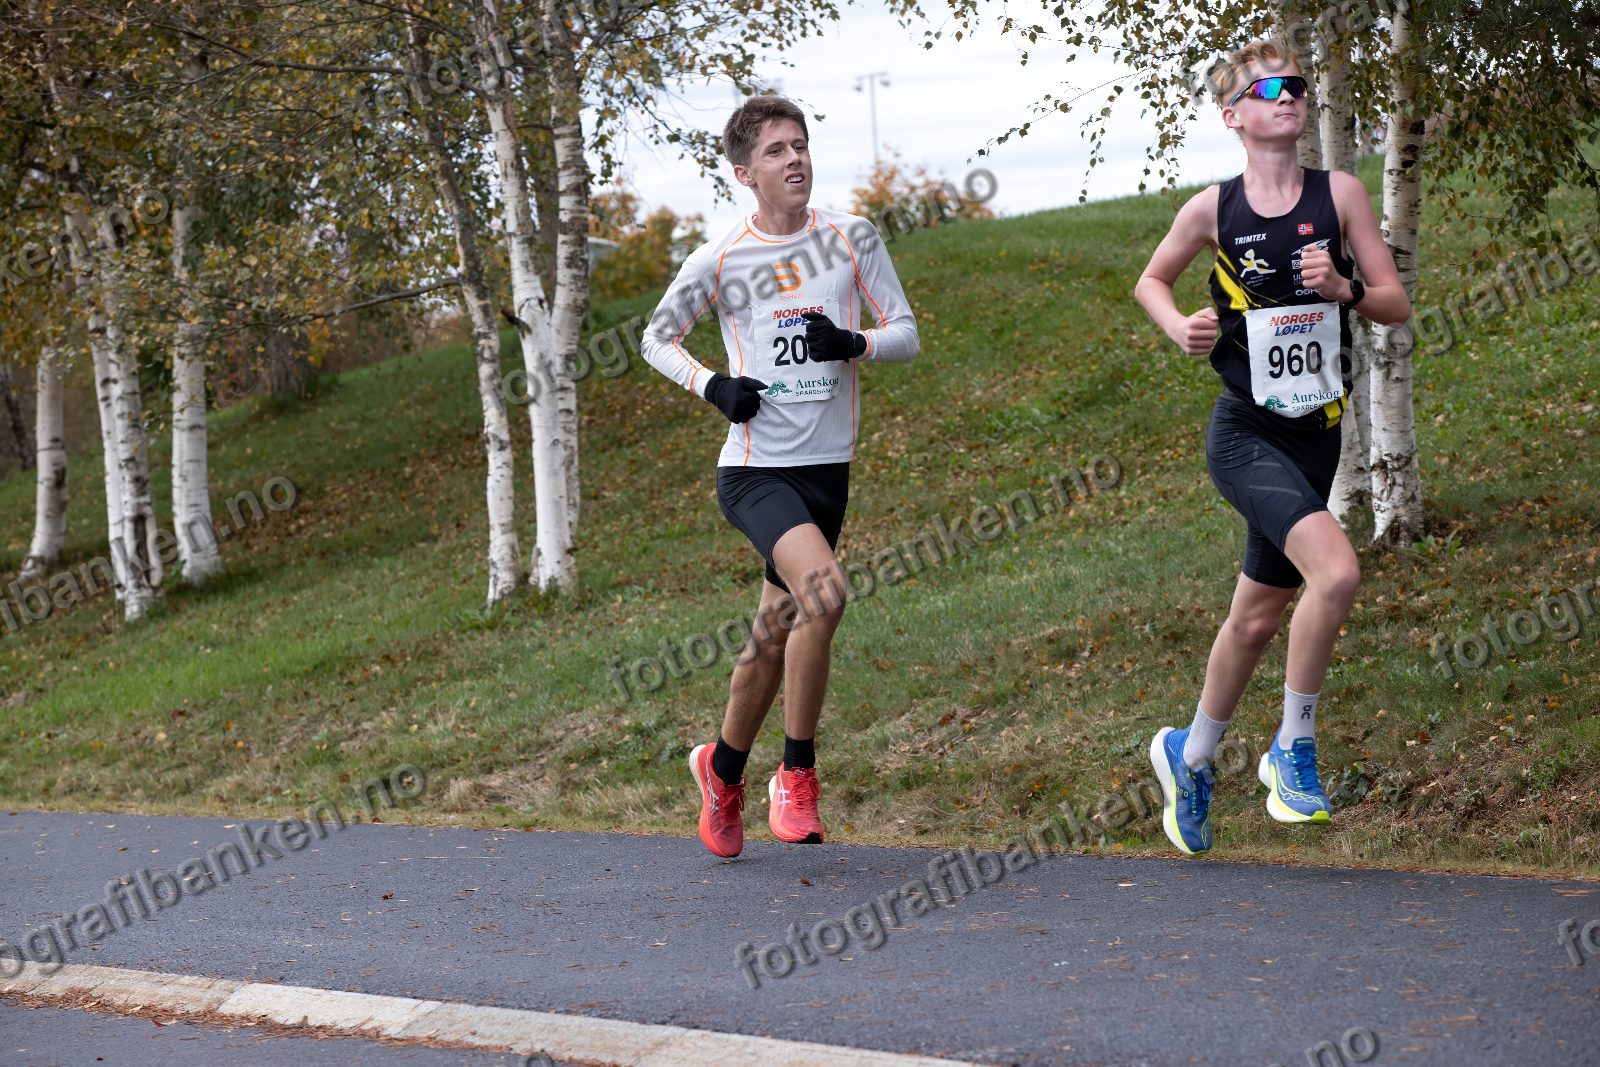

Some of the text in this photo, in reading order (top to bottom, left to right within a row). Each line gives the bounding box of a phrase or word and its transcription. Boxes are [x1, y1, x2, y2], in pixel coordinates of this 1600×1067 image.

[1234, 233, 1267, 245] TRIMTEX
[777, 317, 810, 329] LØPE
[1270, 311, 1325, 327] NORGES
[1274, 323, 1316, 337] LØPET
[773, 334, 809, 367] 20
[1268, 340, 1323, 379] 960
[796, 375, 840, 389] Aurskog
[1292, 389, 1340, 404] Aurskog
